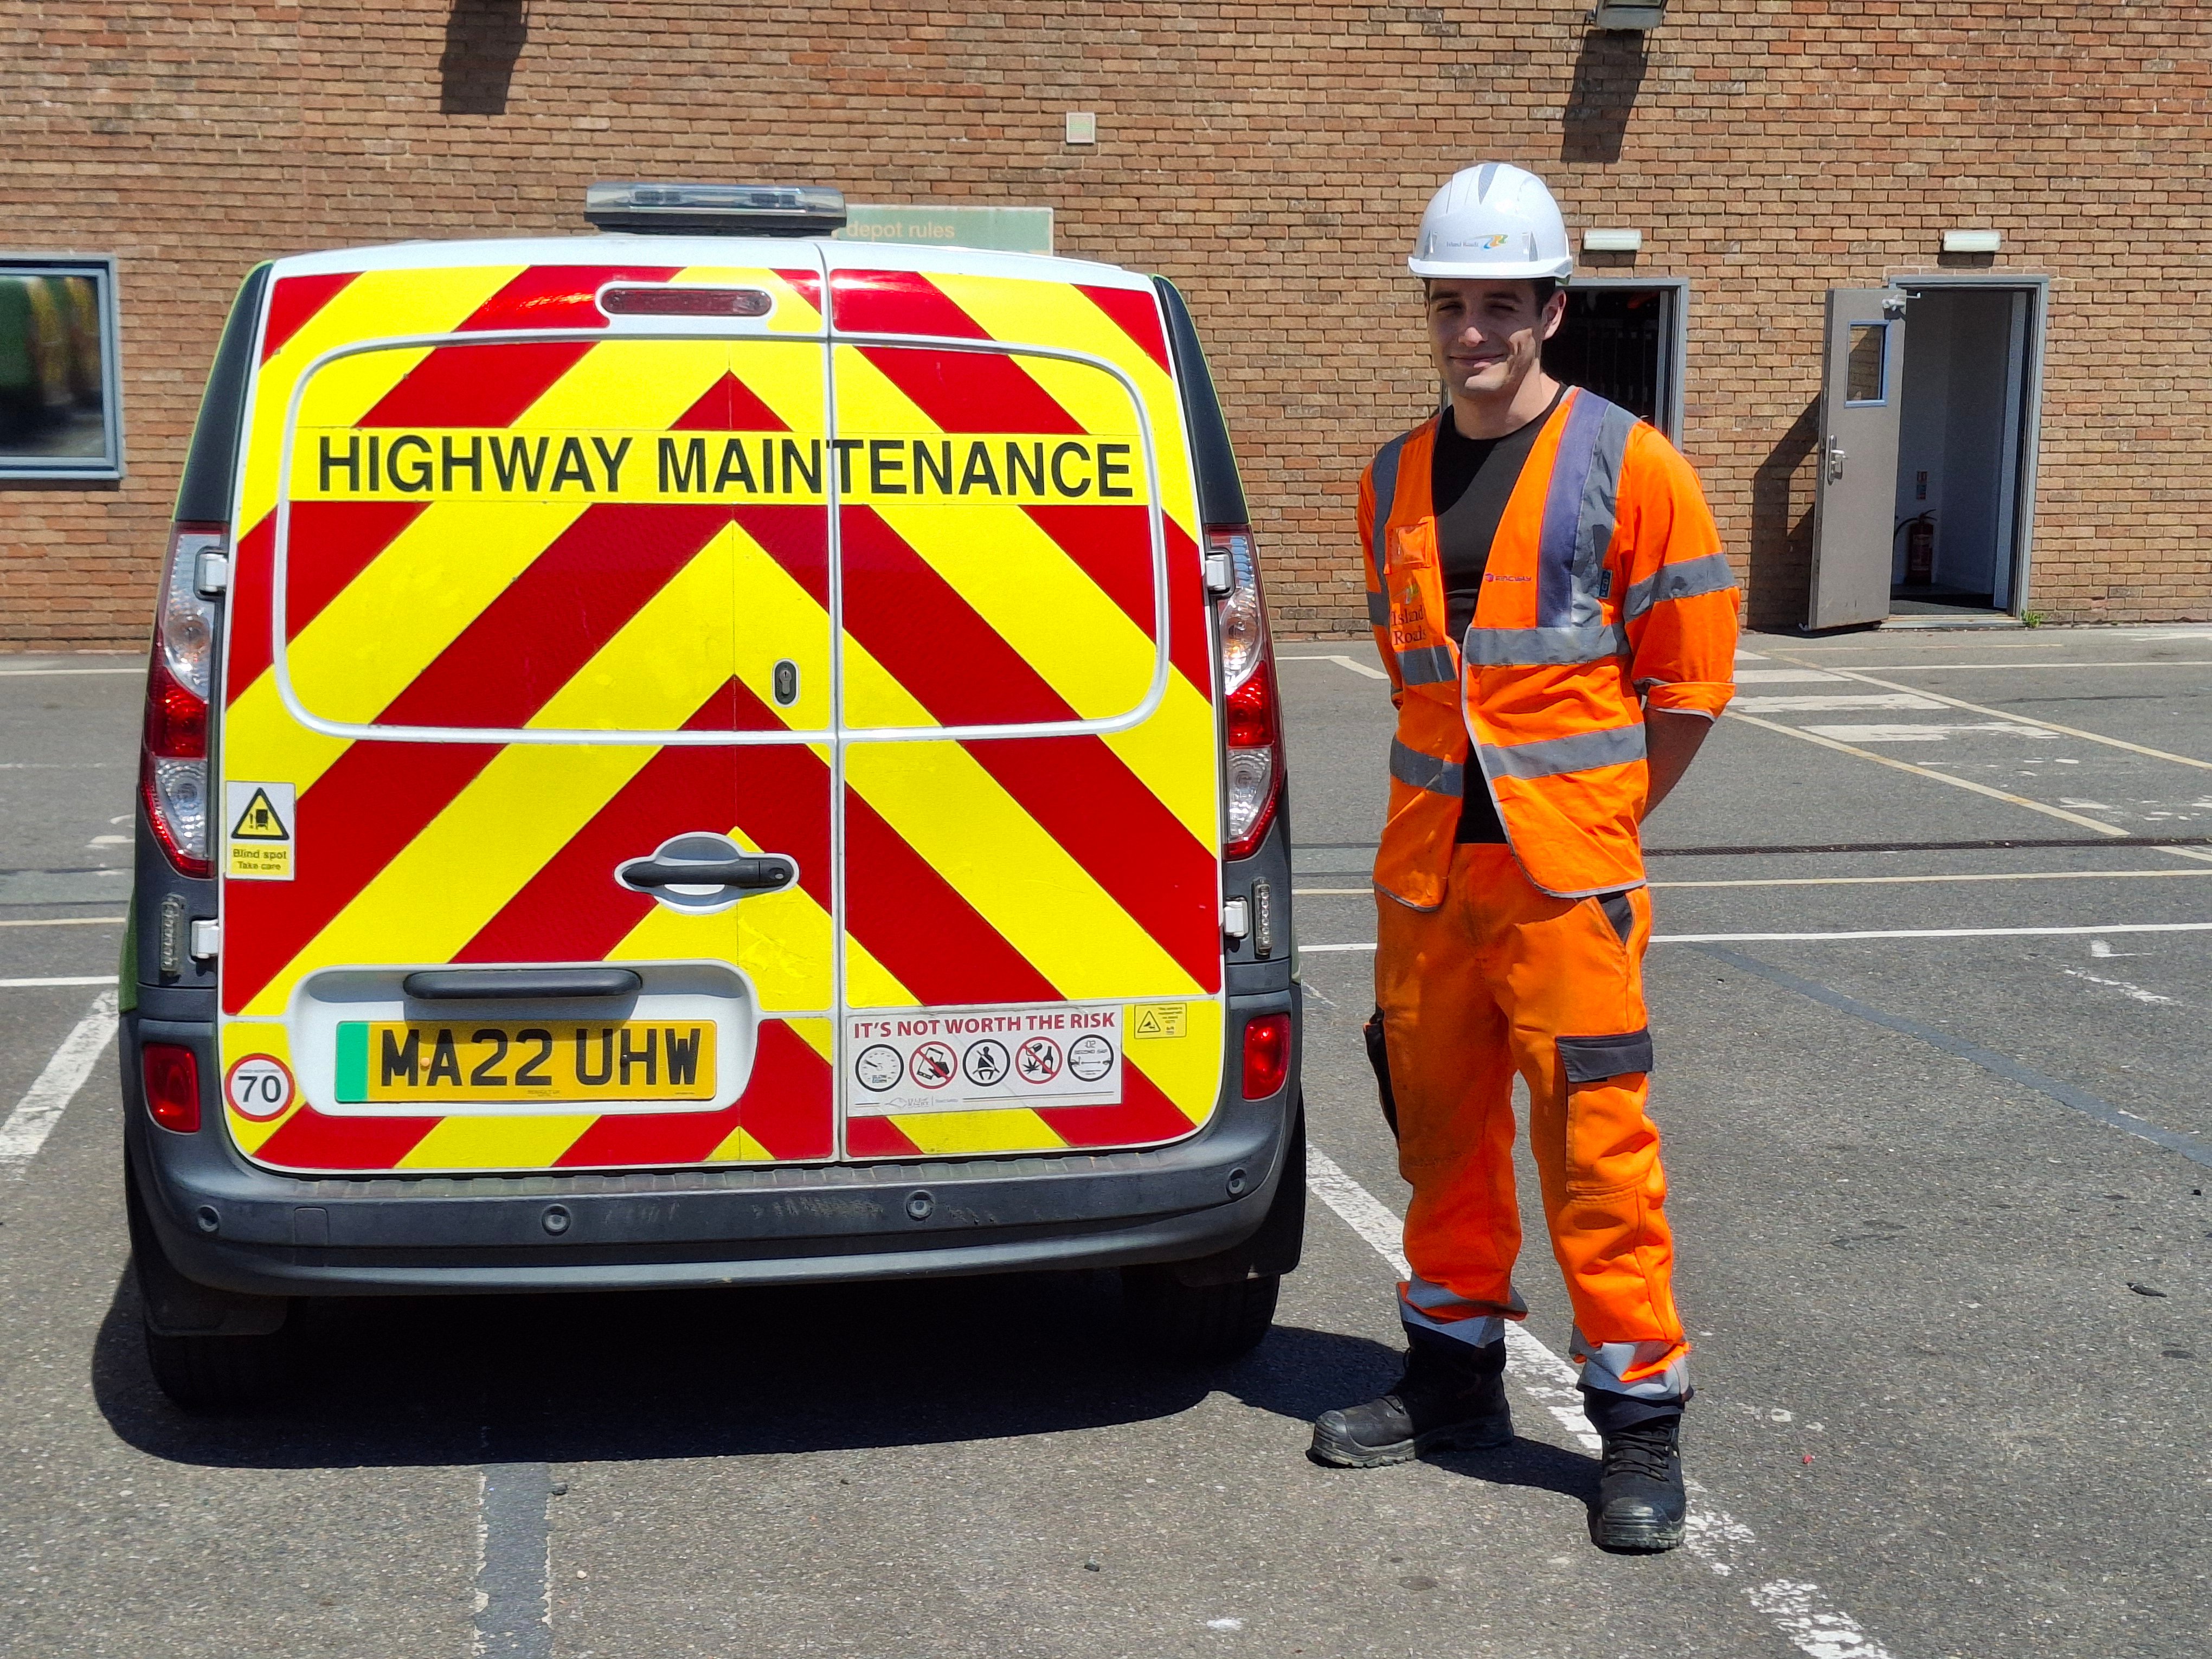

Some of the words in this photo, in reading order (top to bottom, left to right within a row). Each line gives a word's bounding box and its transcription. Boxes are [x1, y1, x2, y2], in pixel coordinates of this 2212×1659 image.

[846, 221, 902, 243] depot
[909, 221, 955, 238] rules
[319, 434, 632, 493] HIGHWAY
[657, 438, 1133, 498] MAINTENANCE
[233, 848, 260, 858] Blind
[263, 851, 287, 860] spot
[237, 861, 259, 870] Take
[854, 1021, 892, 1038] IT'S
[897, 1019, 941, 1036] NOT
[944, 1017, 1021, 1034] WORTH
[1026, 1014, 1065, 1030] THE
[1070, 1012, 1115, 1028] RISK
[381, 1028, 554, 1086] MA22
[575, 1027, 699, 1086] UHW
[238, 1075, 281, 1103] 70
